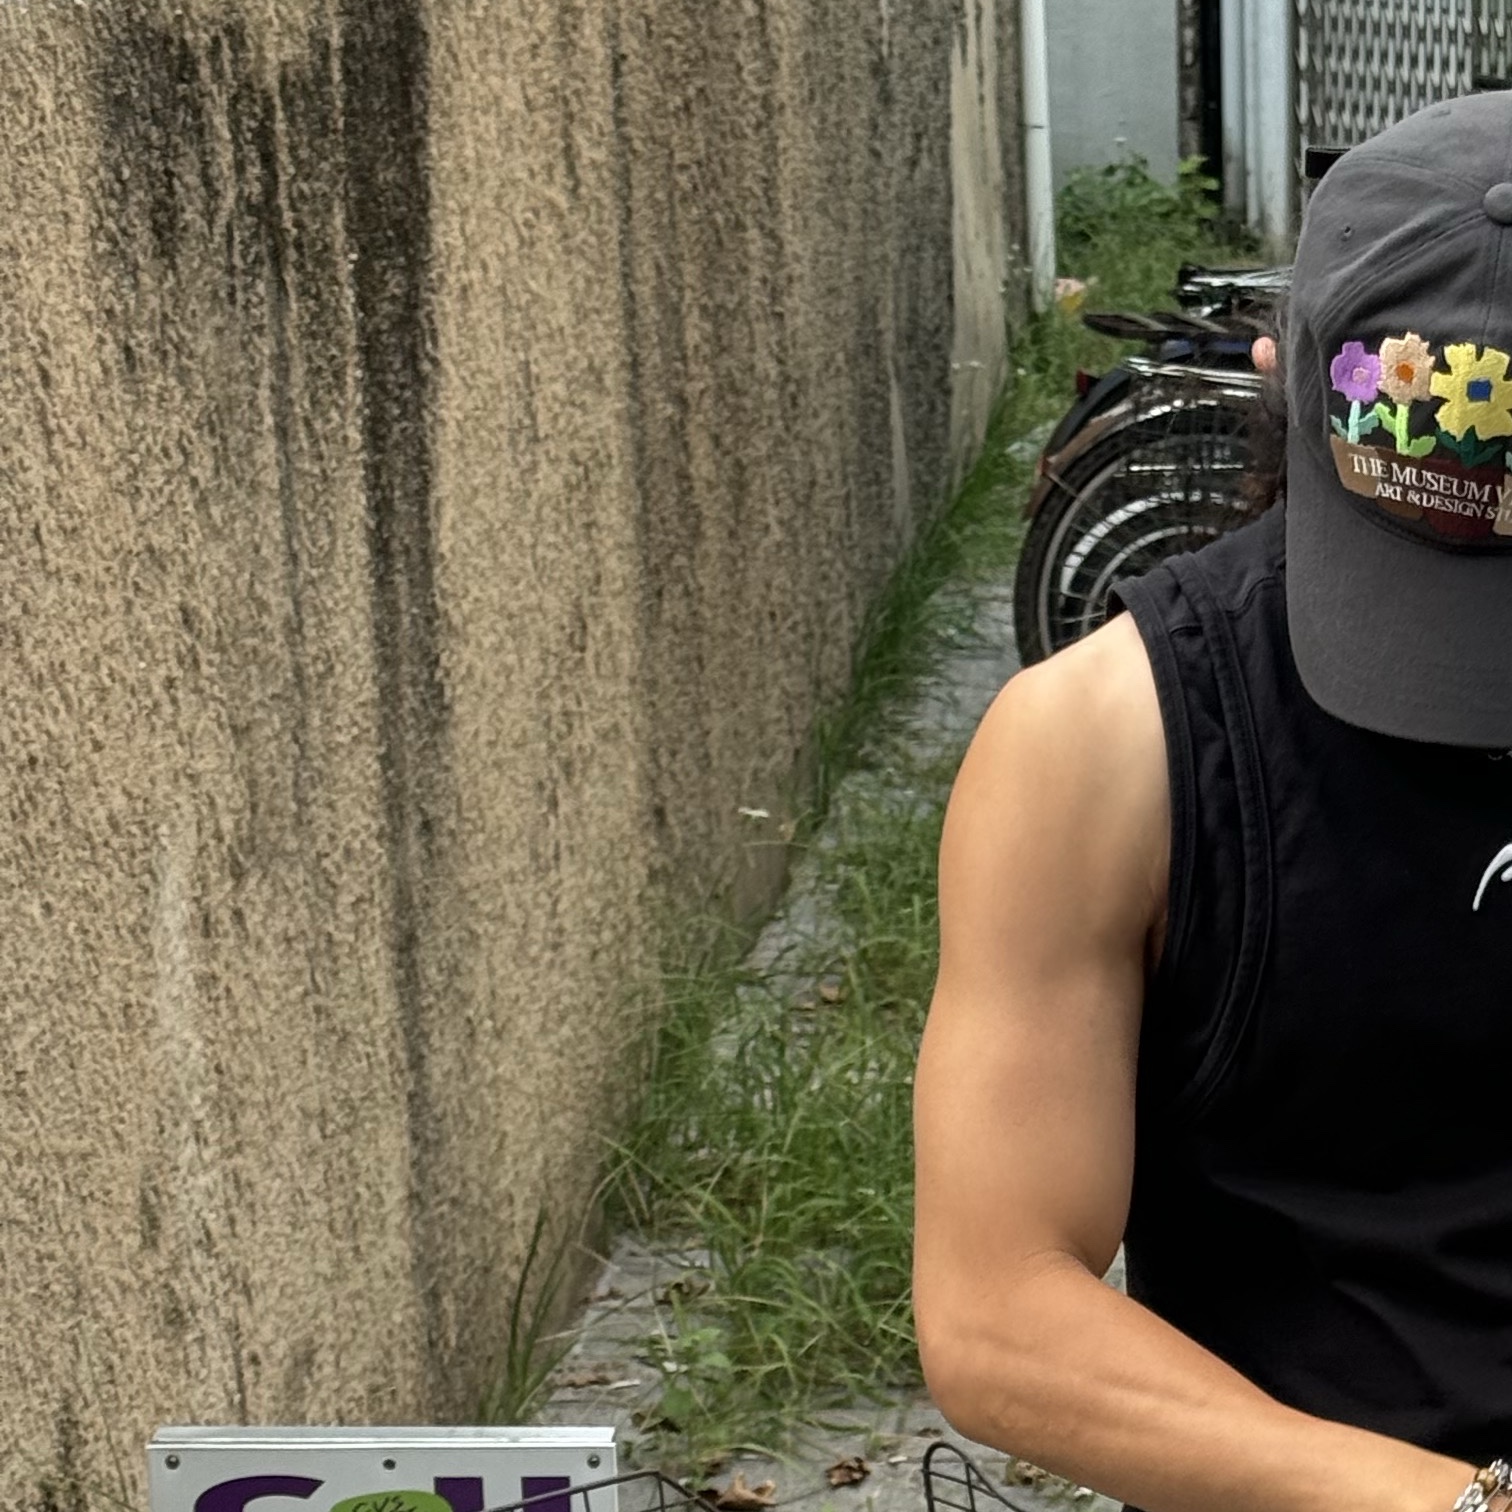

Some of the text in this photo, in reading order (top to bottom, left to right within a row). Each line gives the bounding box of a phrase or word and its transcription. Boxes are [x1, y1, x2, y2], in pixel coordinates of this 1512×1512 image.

[1350, 453, 1388, 478] THE
[1391, 462, 1492, 502] MUSEUM
[1375, 482, 1402, 501] ART
